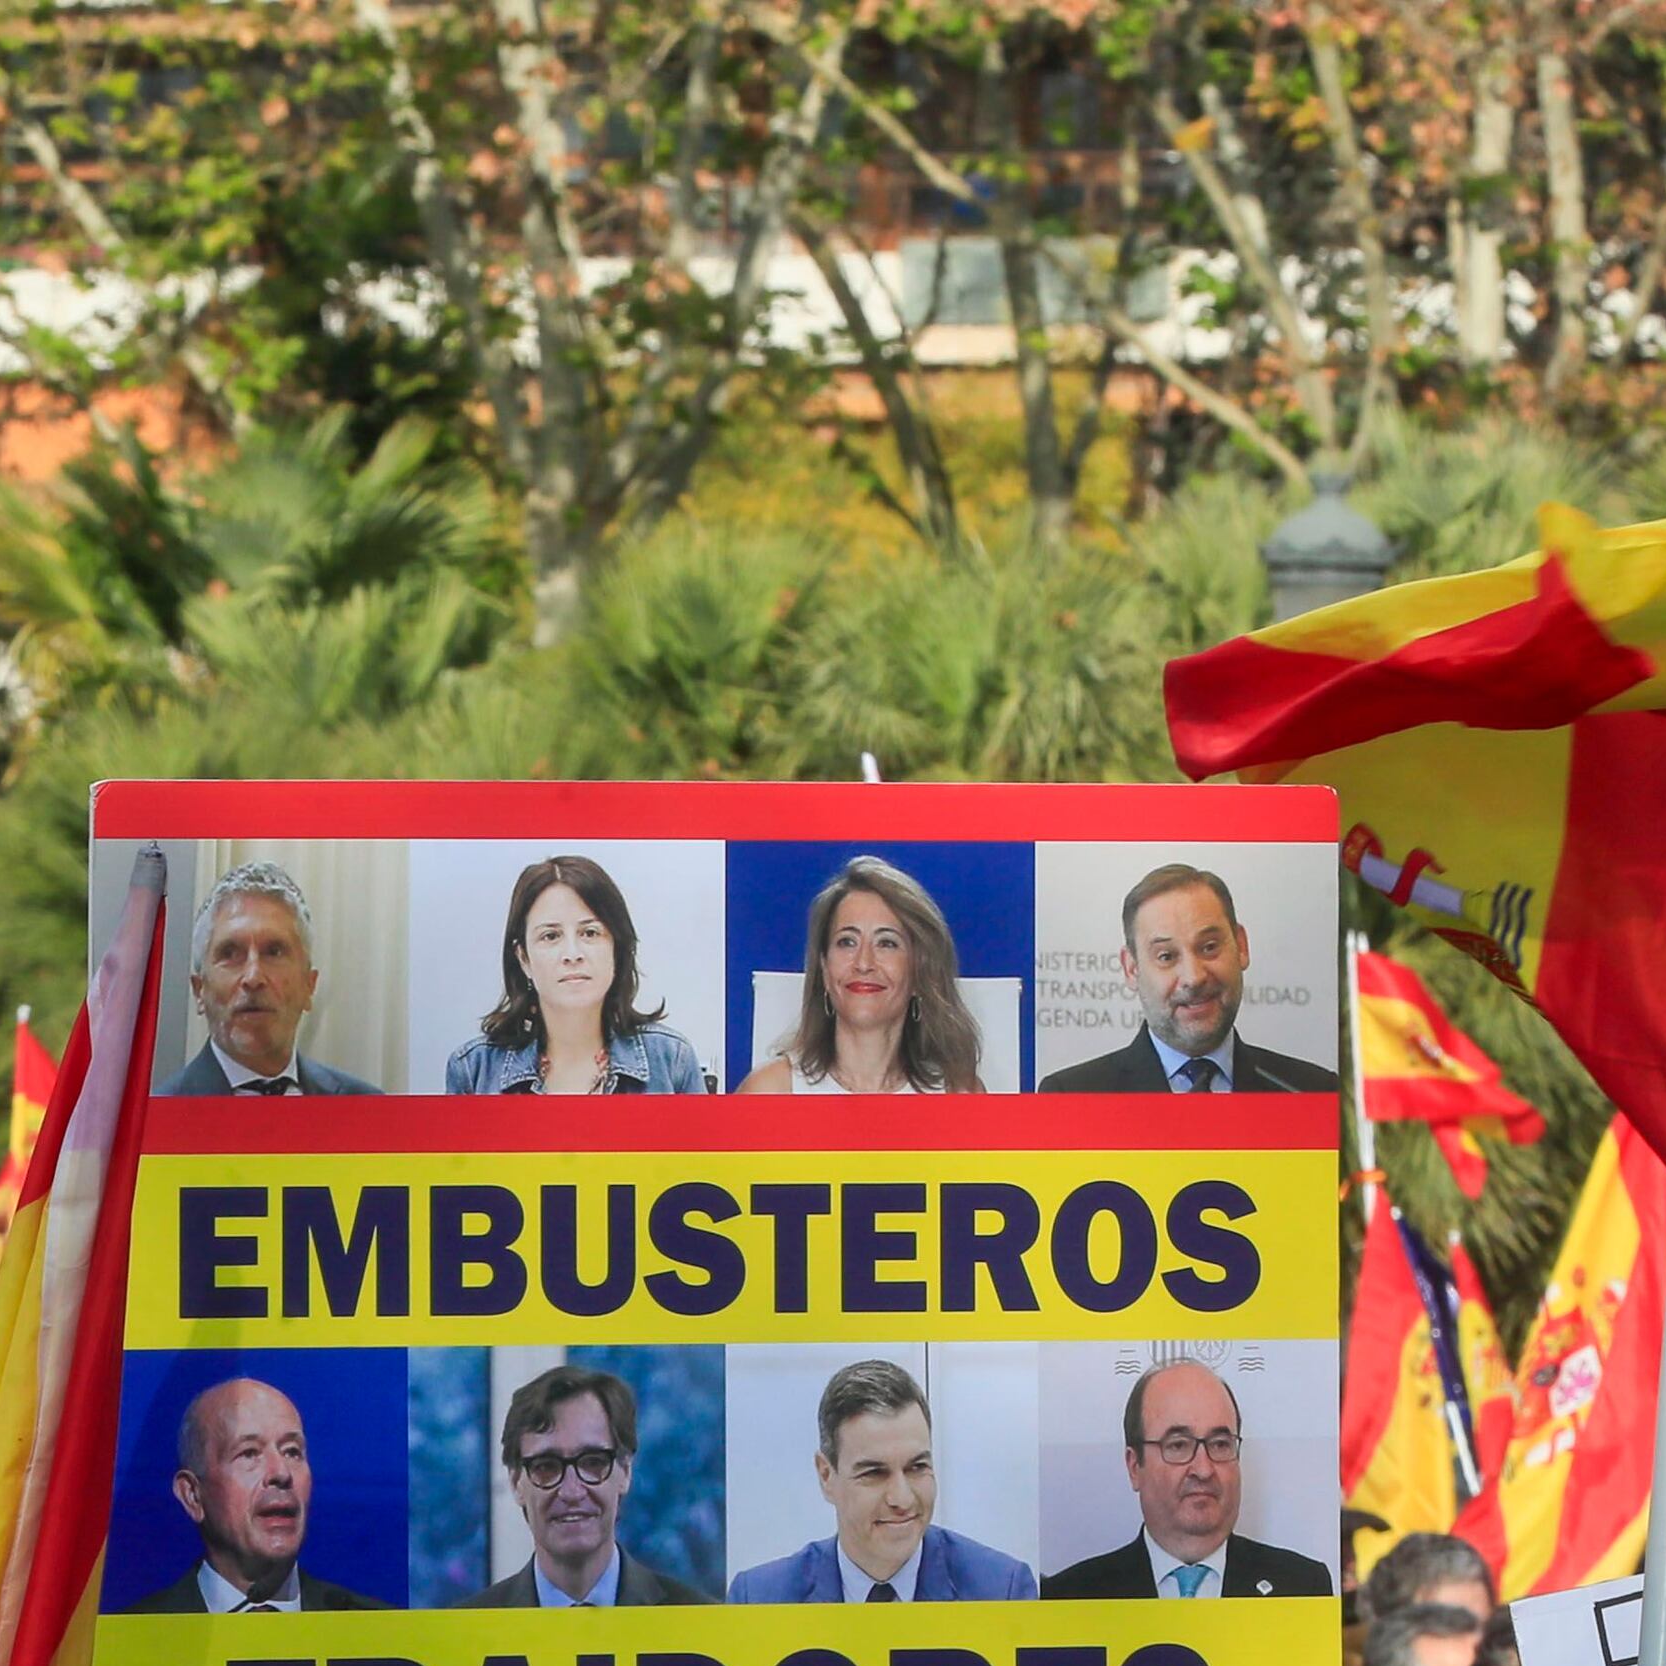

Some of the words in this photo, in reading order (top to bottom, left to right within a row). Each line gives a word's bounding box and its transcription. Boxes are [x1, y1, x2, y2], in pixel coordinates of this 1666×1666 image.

[1036, 980, 1140, 1000] TRANSPO
[1036, 1008, 1114, 1029] GENDA
[179, 1179, 1261, 1320] EMBUSTEROS
